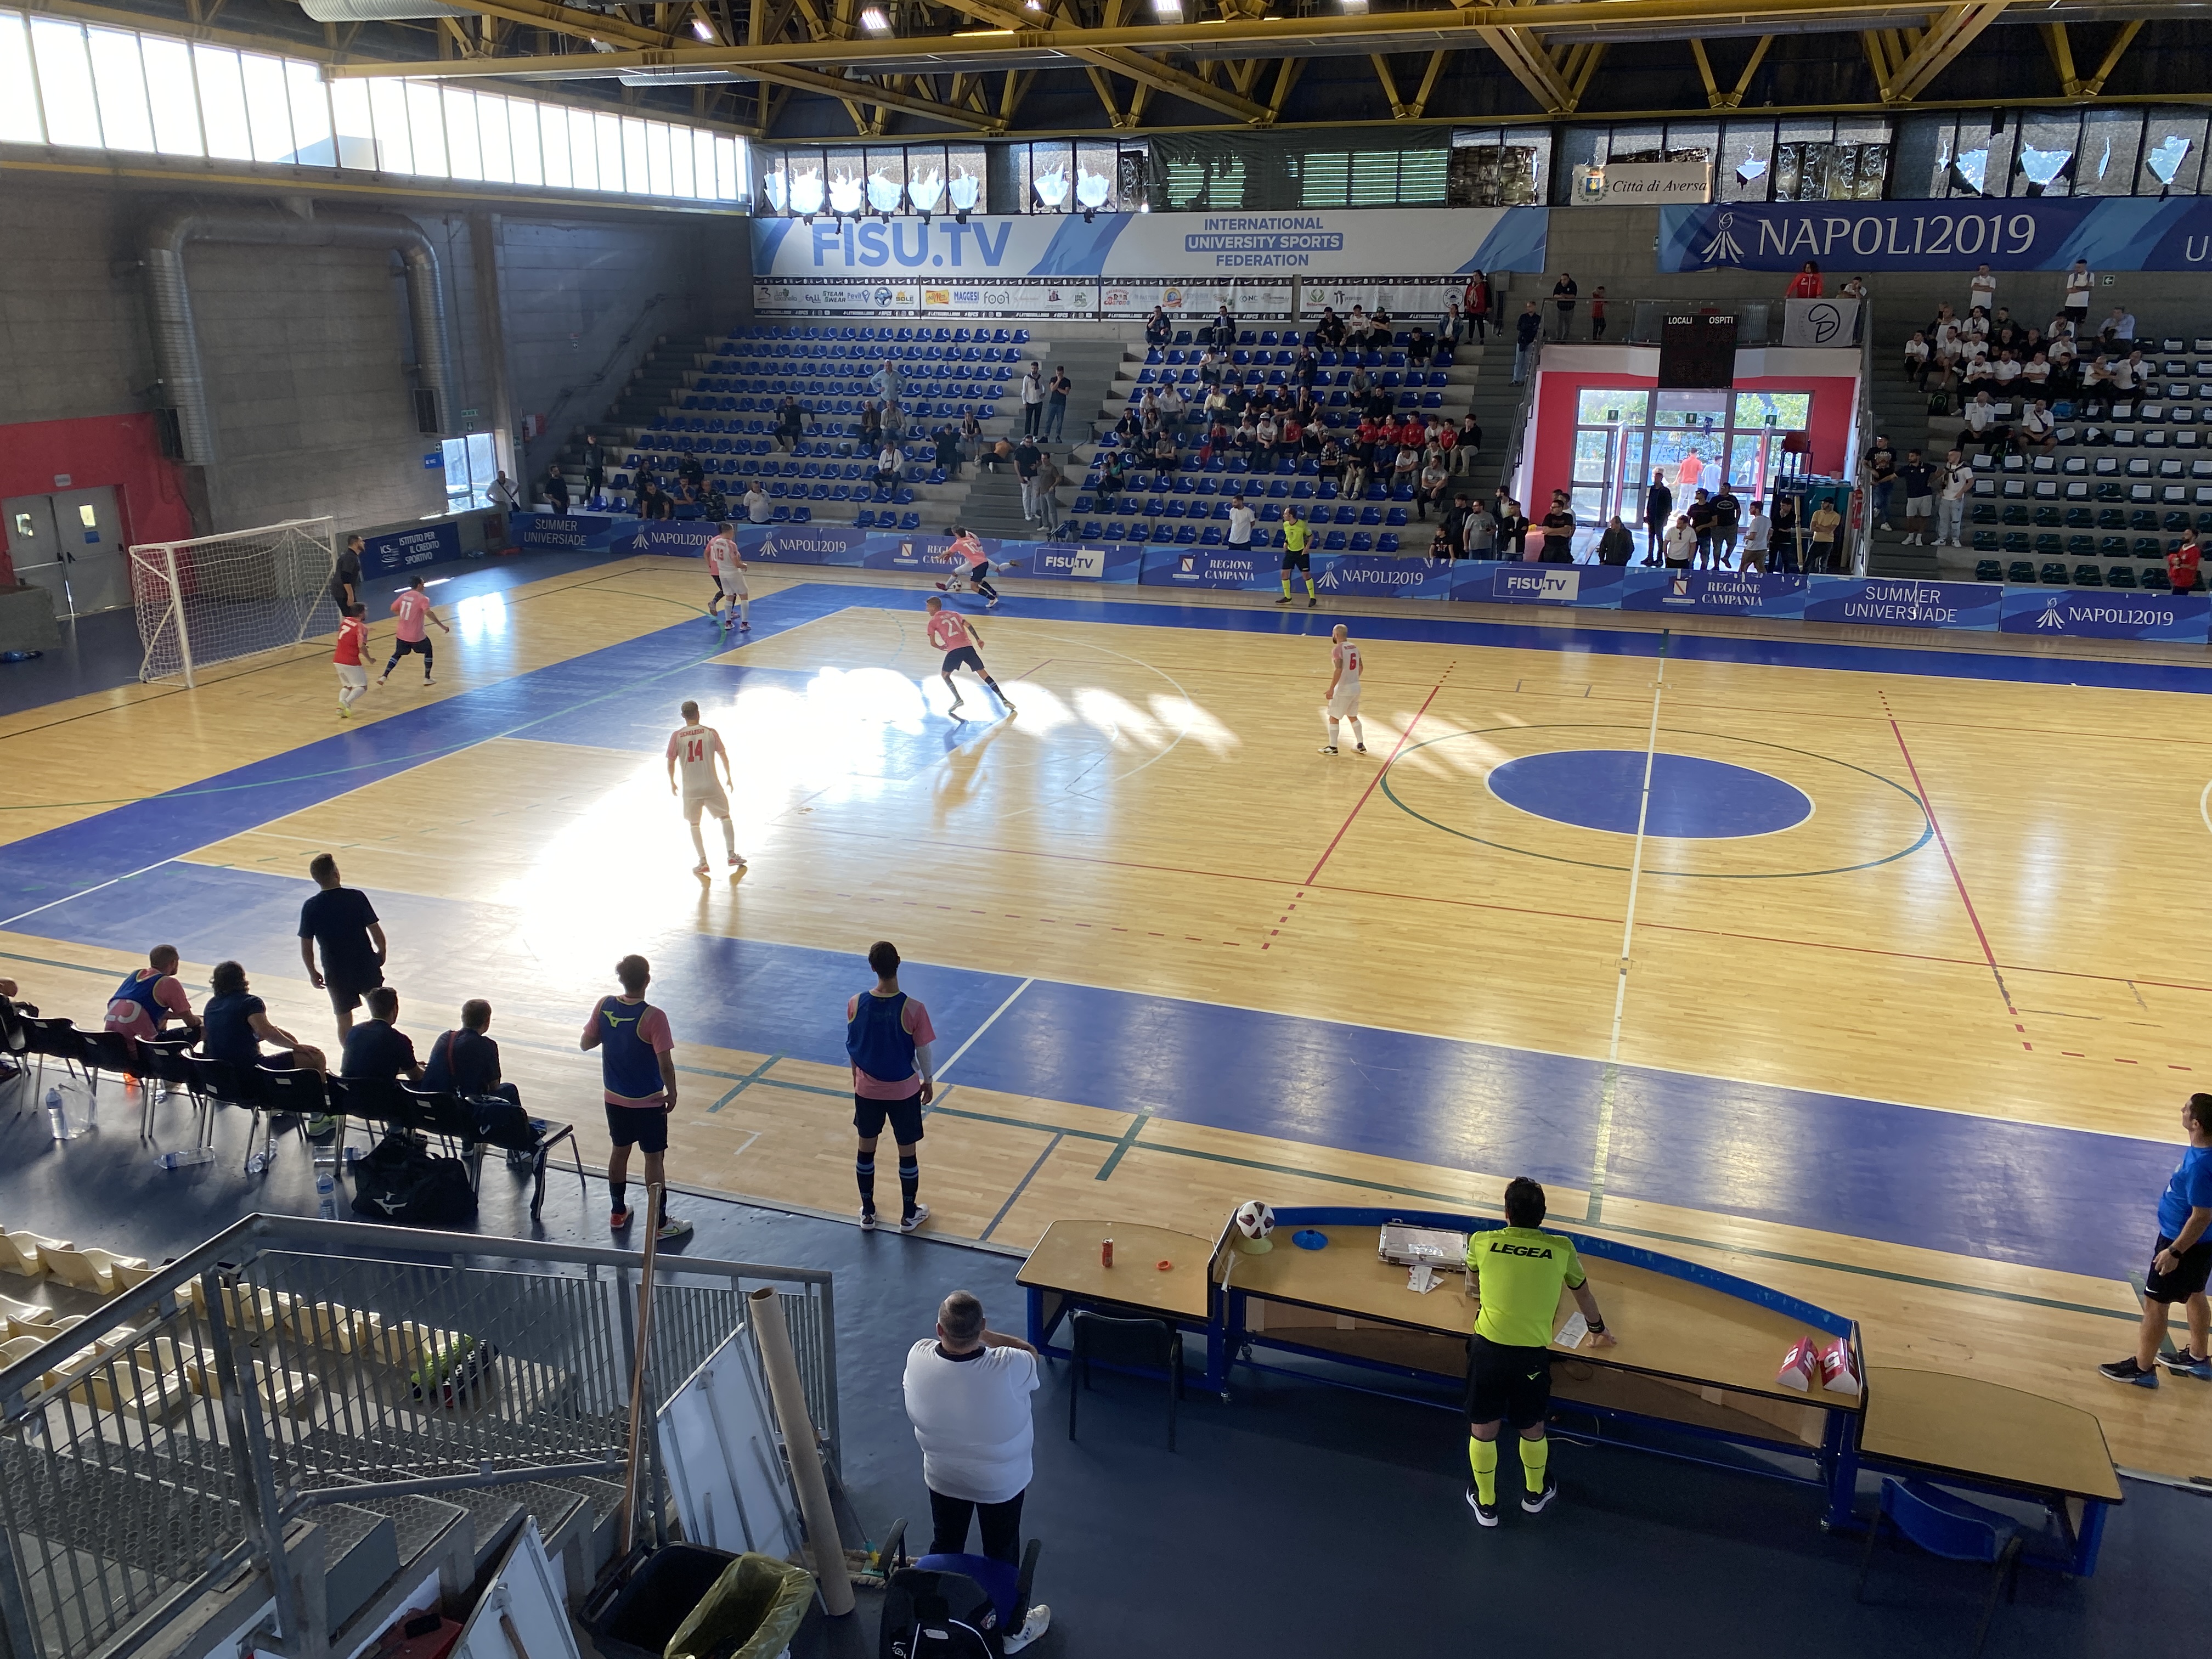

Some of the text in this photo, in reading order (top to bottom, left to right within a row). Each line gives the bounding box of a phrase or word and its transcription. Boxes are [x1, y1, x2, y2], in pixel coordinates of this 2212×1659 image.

[1612, 178, 1707, 193] Città di Aversa
[1204, 217, 1324, 230] INTERNATIONAL
[1188, 235, 1341, 250] UNIVERSITY SPORTS
[1758, 214, 2036, 256] NAPOLI2019
[813, 222, 1012, 267] FISU.TV
[1216, 254, 1310, 267] FEDERATION
[954, 291, 979, 301] MAGGESI
[1668, 316, 1692, 324] LOCALI
[1709, 316, 1734, 324] OSPITI
[535, 518, 577, 532] SUMMER
[399, 531, 436, 546] ISTITUTO PER
[415, 540, 439, 552] CREDITO
[524, 531, 587, 546] UNIVERSIADE
[650, 532, 714, 546] NAPOLI2019
[780, 539, 847, 553] NAPOLI2019
[380, 544, 391, 555] ICS
[405, 551, 433, 566] SPORTIVO
[1045, 556, 1094, 569] FISU.TV
[1210, 558, 1254, 571] REGIONE
[1205, 570, 1255, 582] CAMPANIA
[1342, 569, 1424, 585] NAPOLI2019
[1507, 576, 1567, 591] FISU.TV
[1708, 582, 1761, 594] REGIONE
[1865, 586, 1941, 603] SUMMER
[1701, 594, 1763, 607] CAMPANIA
[400, 601, 412, 620] 11
[1844, 602, 1958, 623] UNIVERSIADE
[2069, 607, 2174, 626] NAPOLI2019
[339, 624, 351, 640] 7
[941, 616, 963, 637] 21
[1349, 652, 1357, 670] 6
[687, 739, 703, 762] 14
[1489, 1242, 1553, 1260] LEGEA
